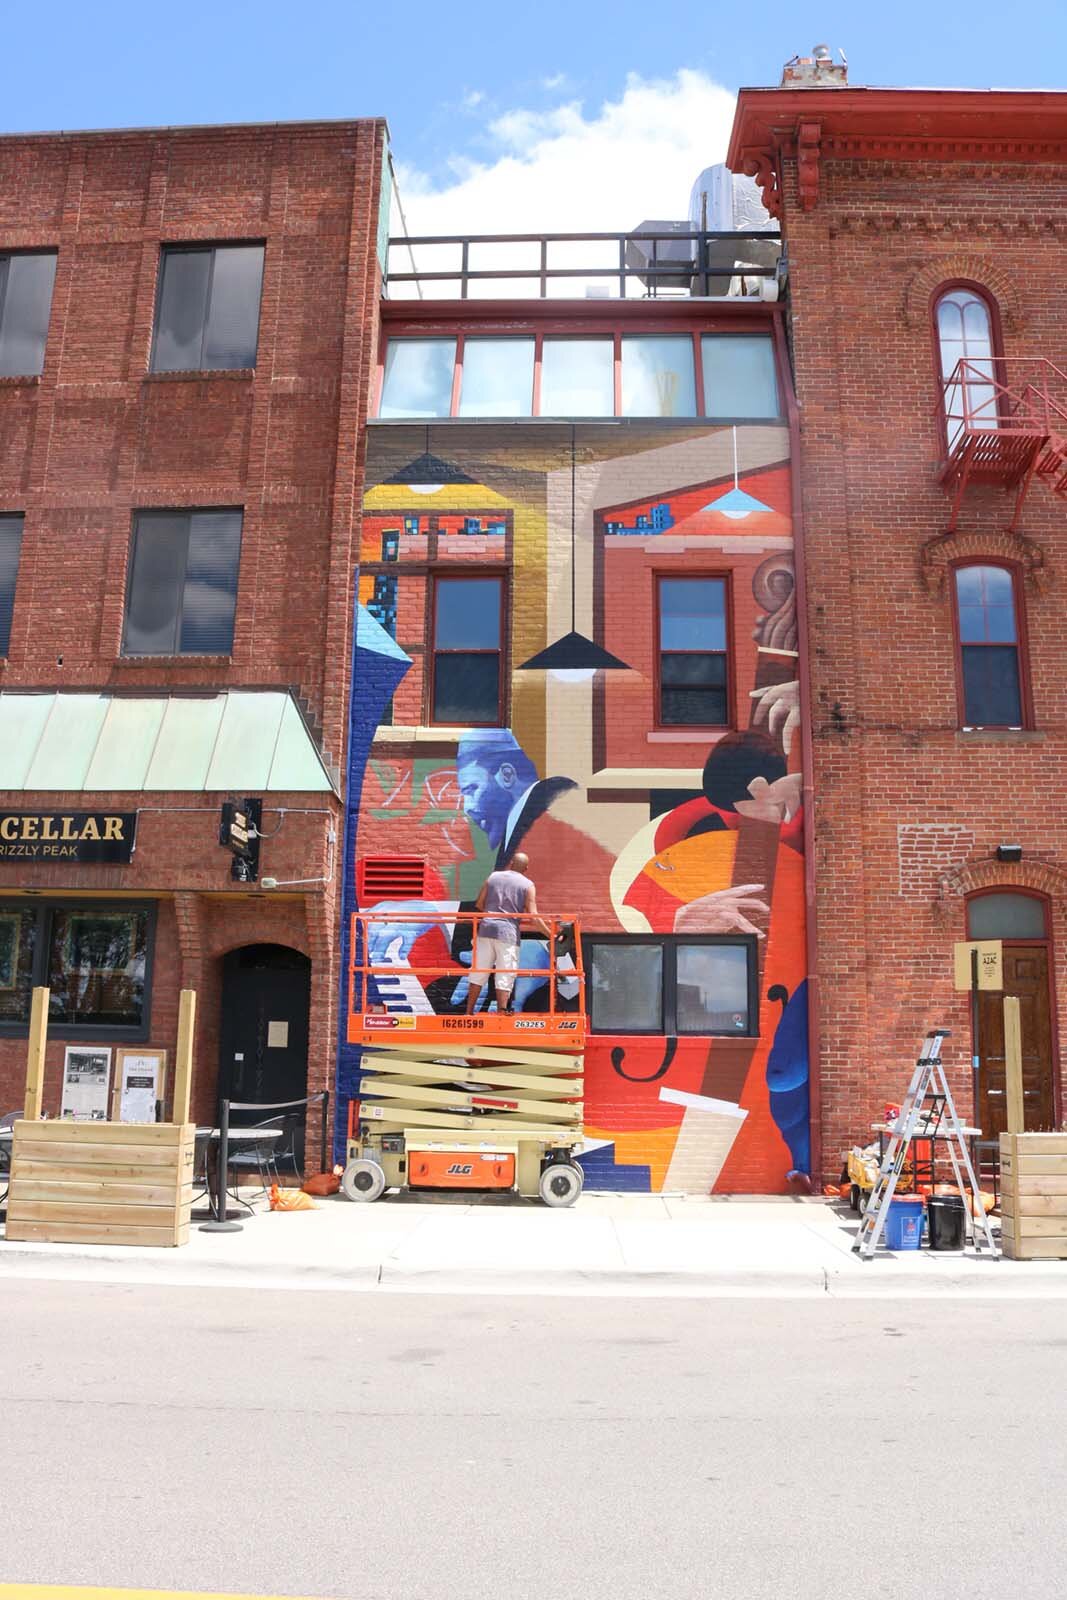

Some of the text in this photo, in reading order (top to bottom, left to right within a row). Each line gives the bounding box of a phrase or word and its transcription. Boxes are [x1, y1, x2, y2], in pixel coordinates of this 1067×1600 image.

[1, 817, 124, 840] CELLAR
[43, 846, 77, 856] PEAK
[442, 1019, 484, 1029] 16261599
[558, 1021, 577, 1029] JLG
[448, 1164, 472, 1174] JLG
